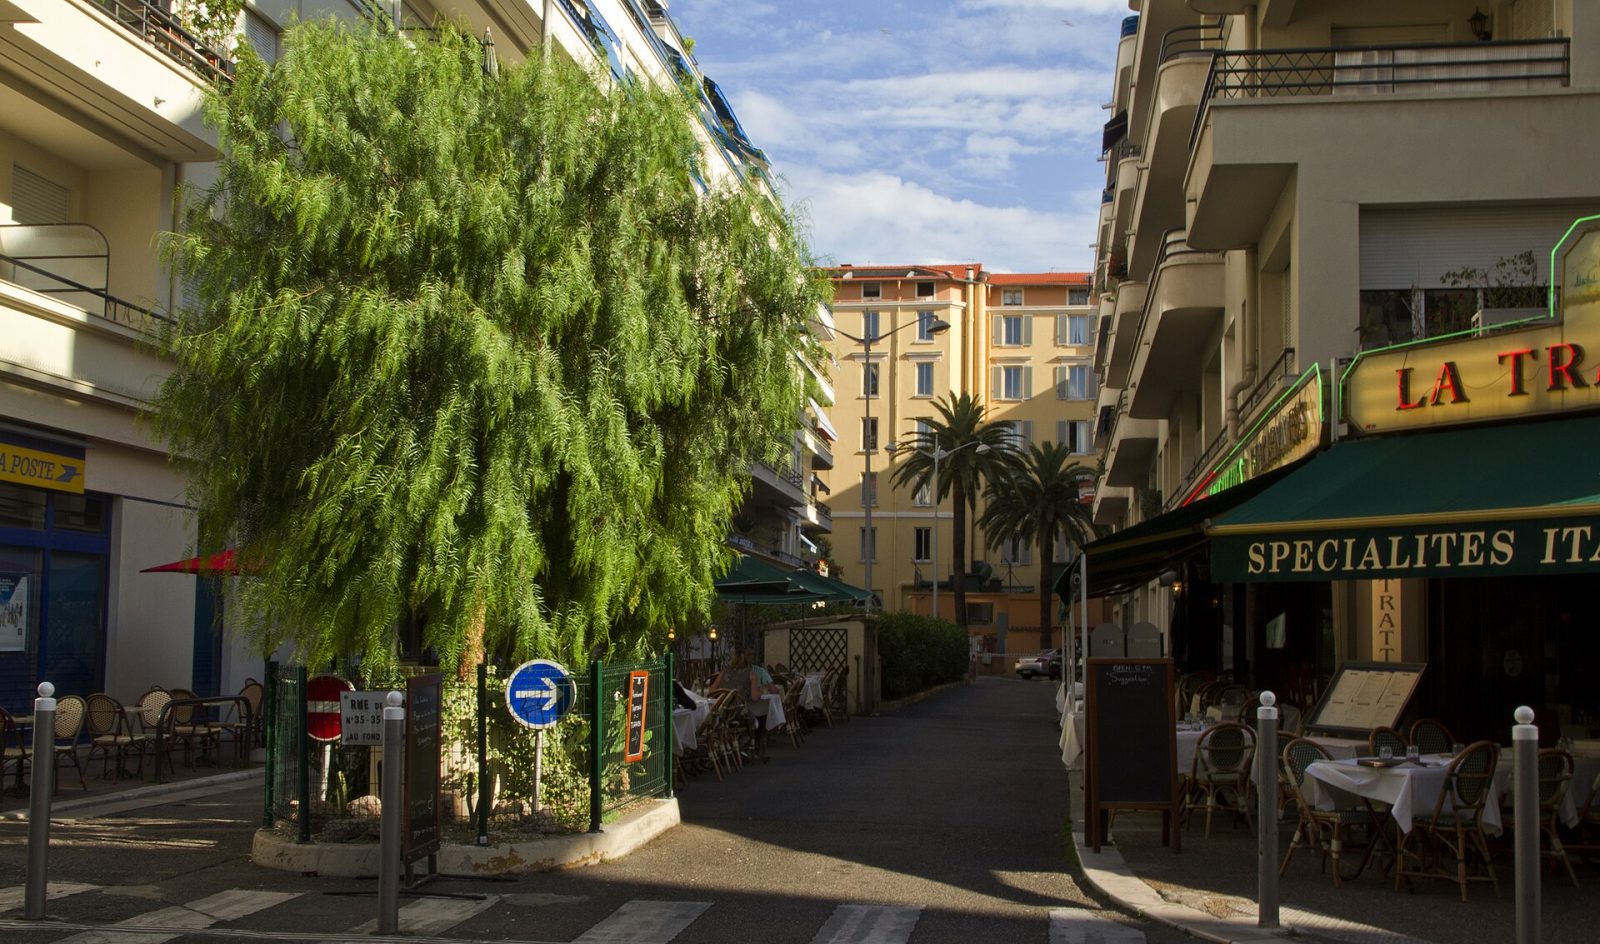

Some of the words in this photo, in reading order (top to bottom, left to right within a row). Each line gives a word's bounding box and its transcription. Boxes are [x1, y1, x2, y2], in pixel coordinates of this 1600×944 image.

[1396, 361, 1471, 411] LA
[10, 454, 55, 480] POSTE
[1247, 529, 1516, 575] SPECIALITES
[351, 699, 369, 710] RUE
[350, 733, 359, 741] AU
[363, 733, 381, 741] FOND
